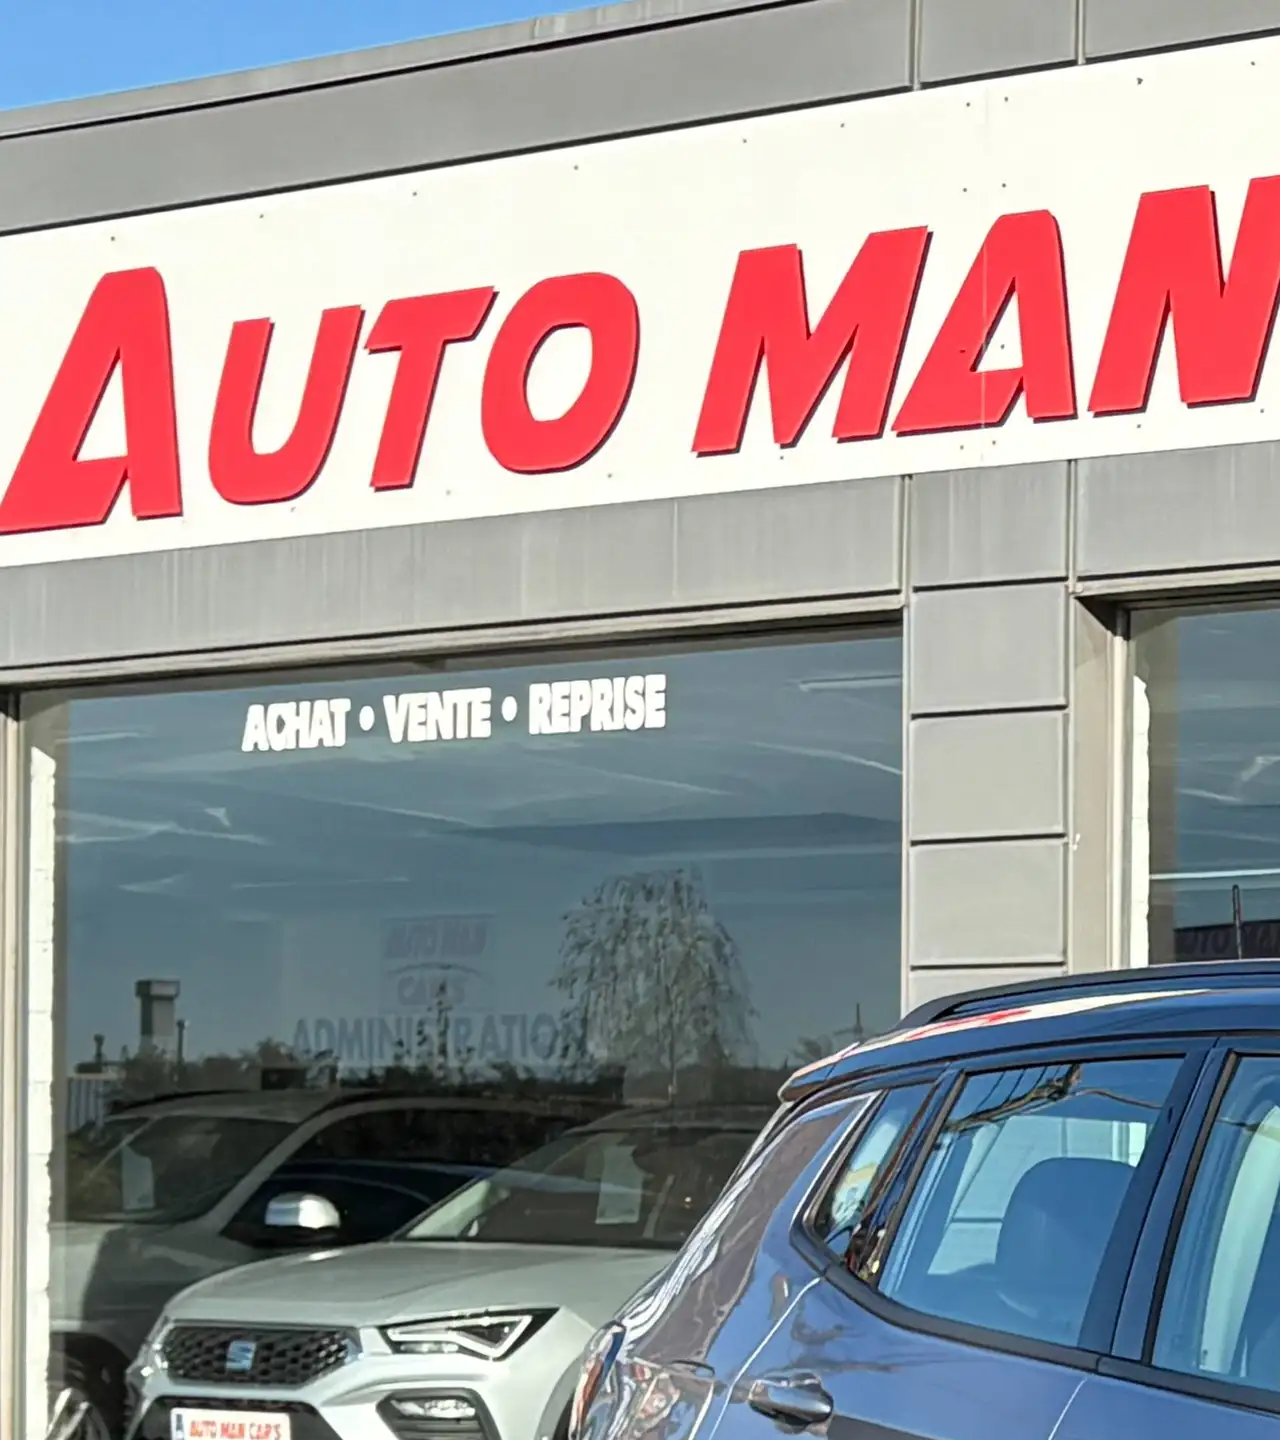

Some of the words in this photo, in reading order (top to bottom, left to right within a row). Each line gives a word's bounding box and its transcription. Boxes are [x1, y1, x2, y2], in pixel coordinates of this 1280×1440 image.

[0, 267, 641, 534] AUTO
[241, 698, 351, 752] ACHAT
[382, 687, 492, 743] VENTE
[528, 674, 667, 735] REPRISE
